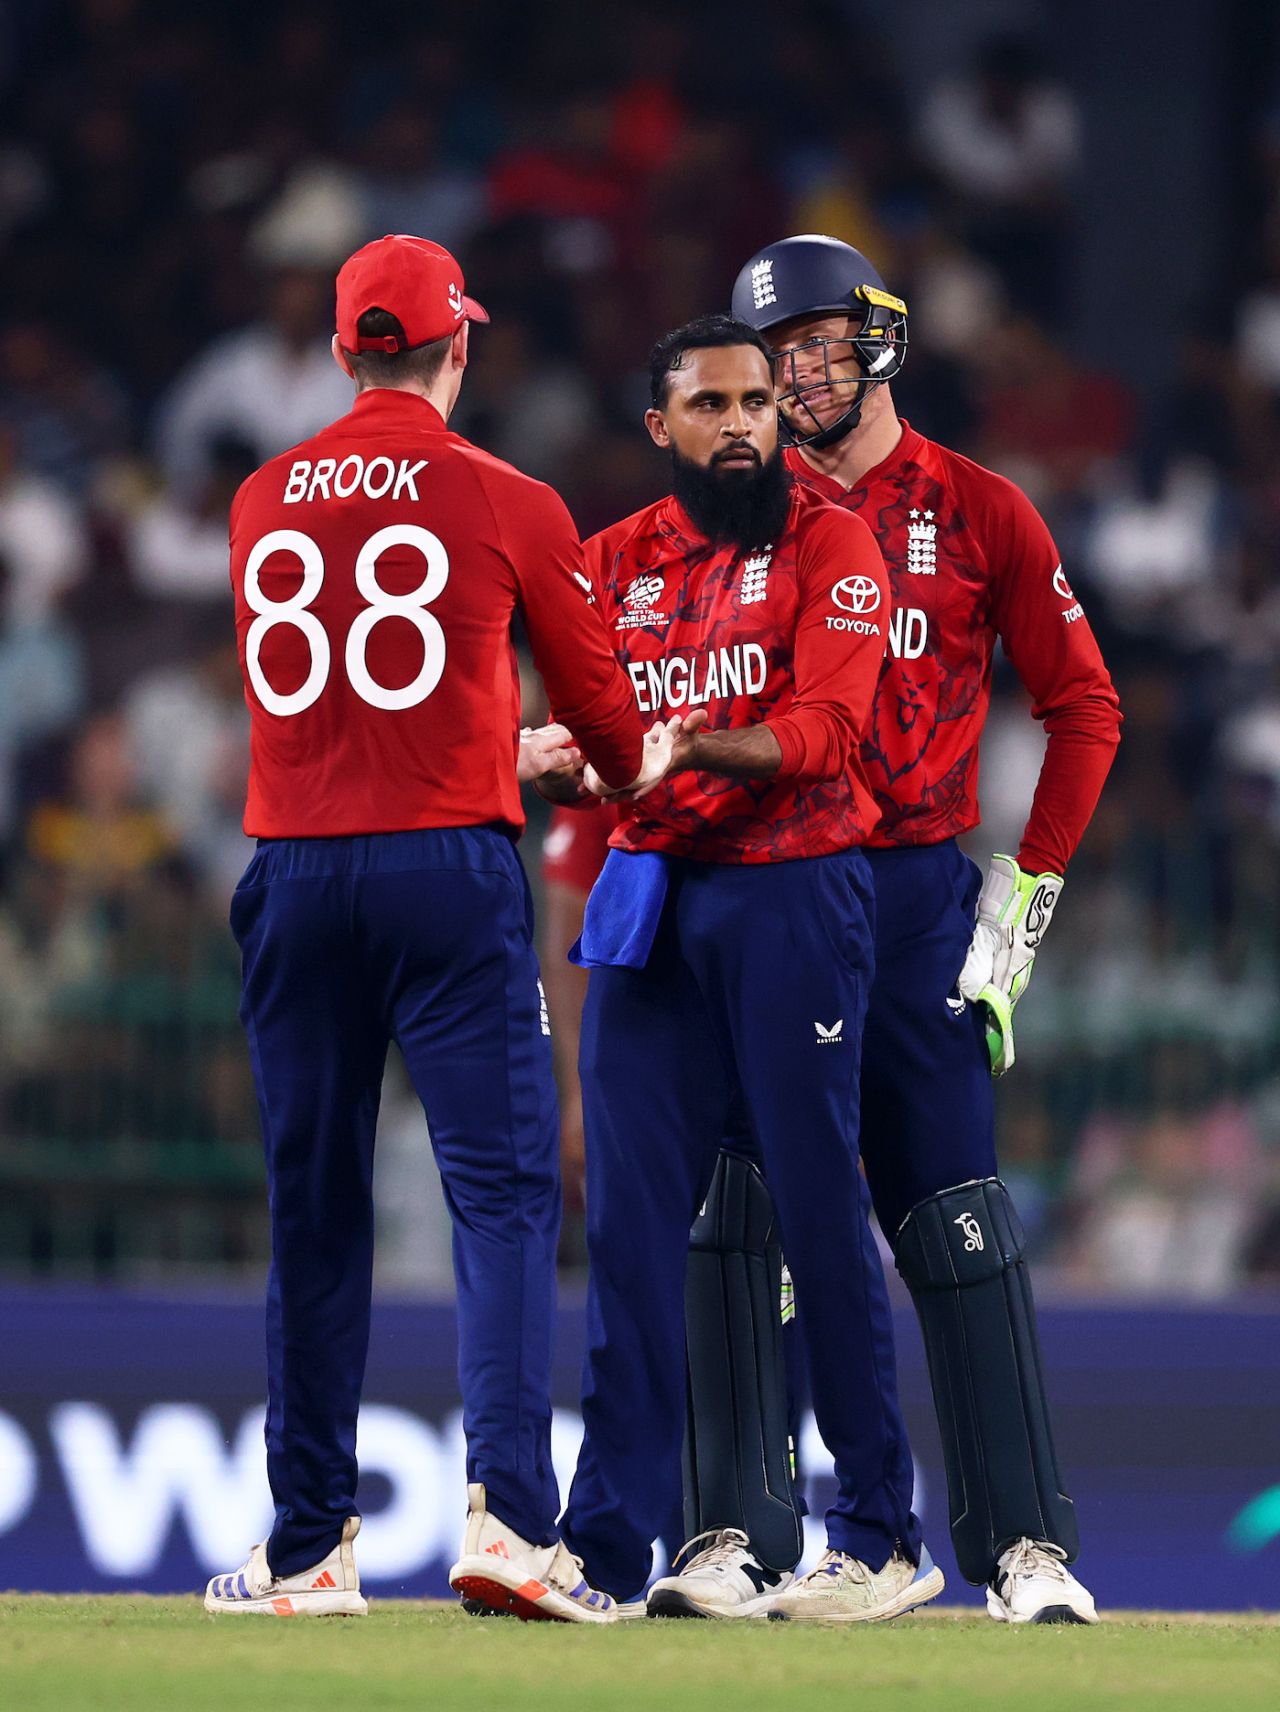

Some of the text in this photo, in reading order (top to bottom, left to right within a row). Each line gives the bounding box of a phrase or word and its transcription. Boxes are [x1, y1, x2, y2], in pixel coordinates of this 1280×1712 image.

[283, 455, 429, 504] BROOK
[243, 524, 449, 717] 88
[618, 615, 647, 624] WORLD
[825, 616, 880, 636] TOYOTA
[627, 642, 768, 712] ENGLAND
